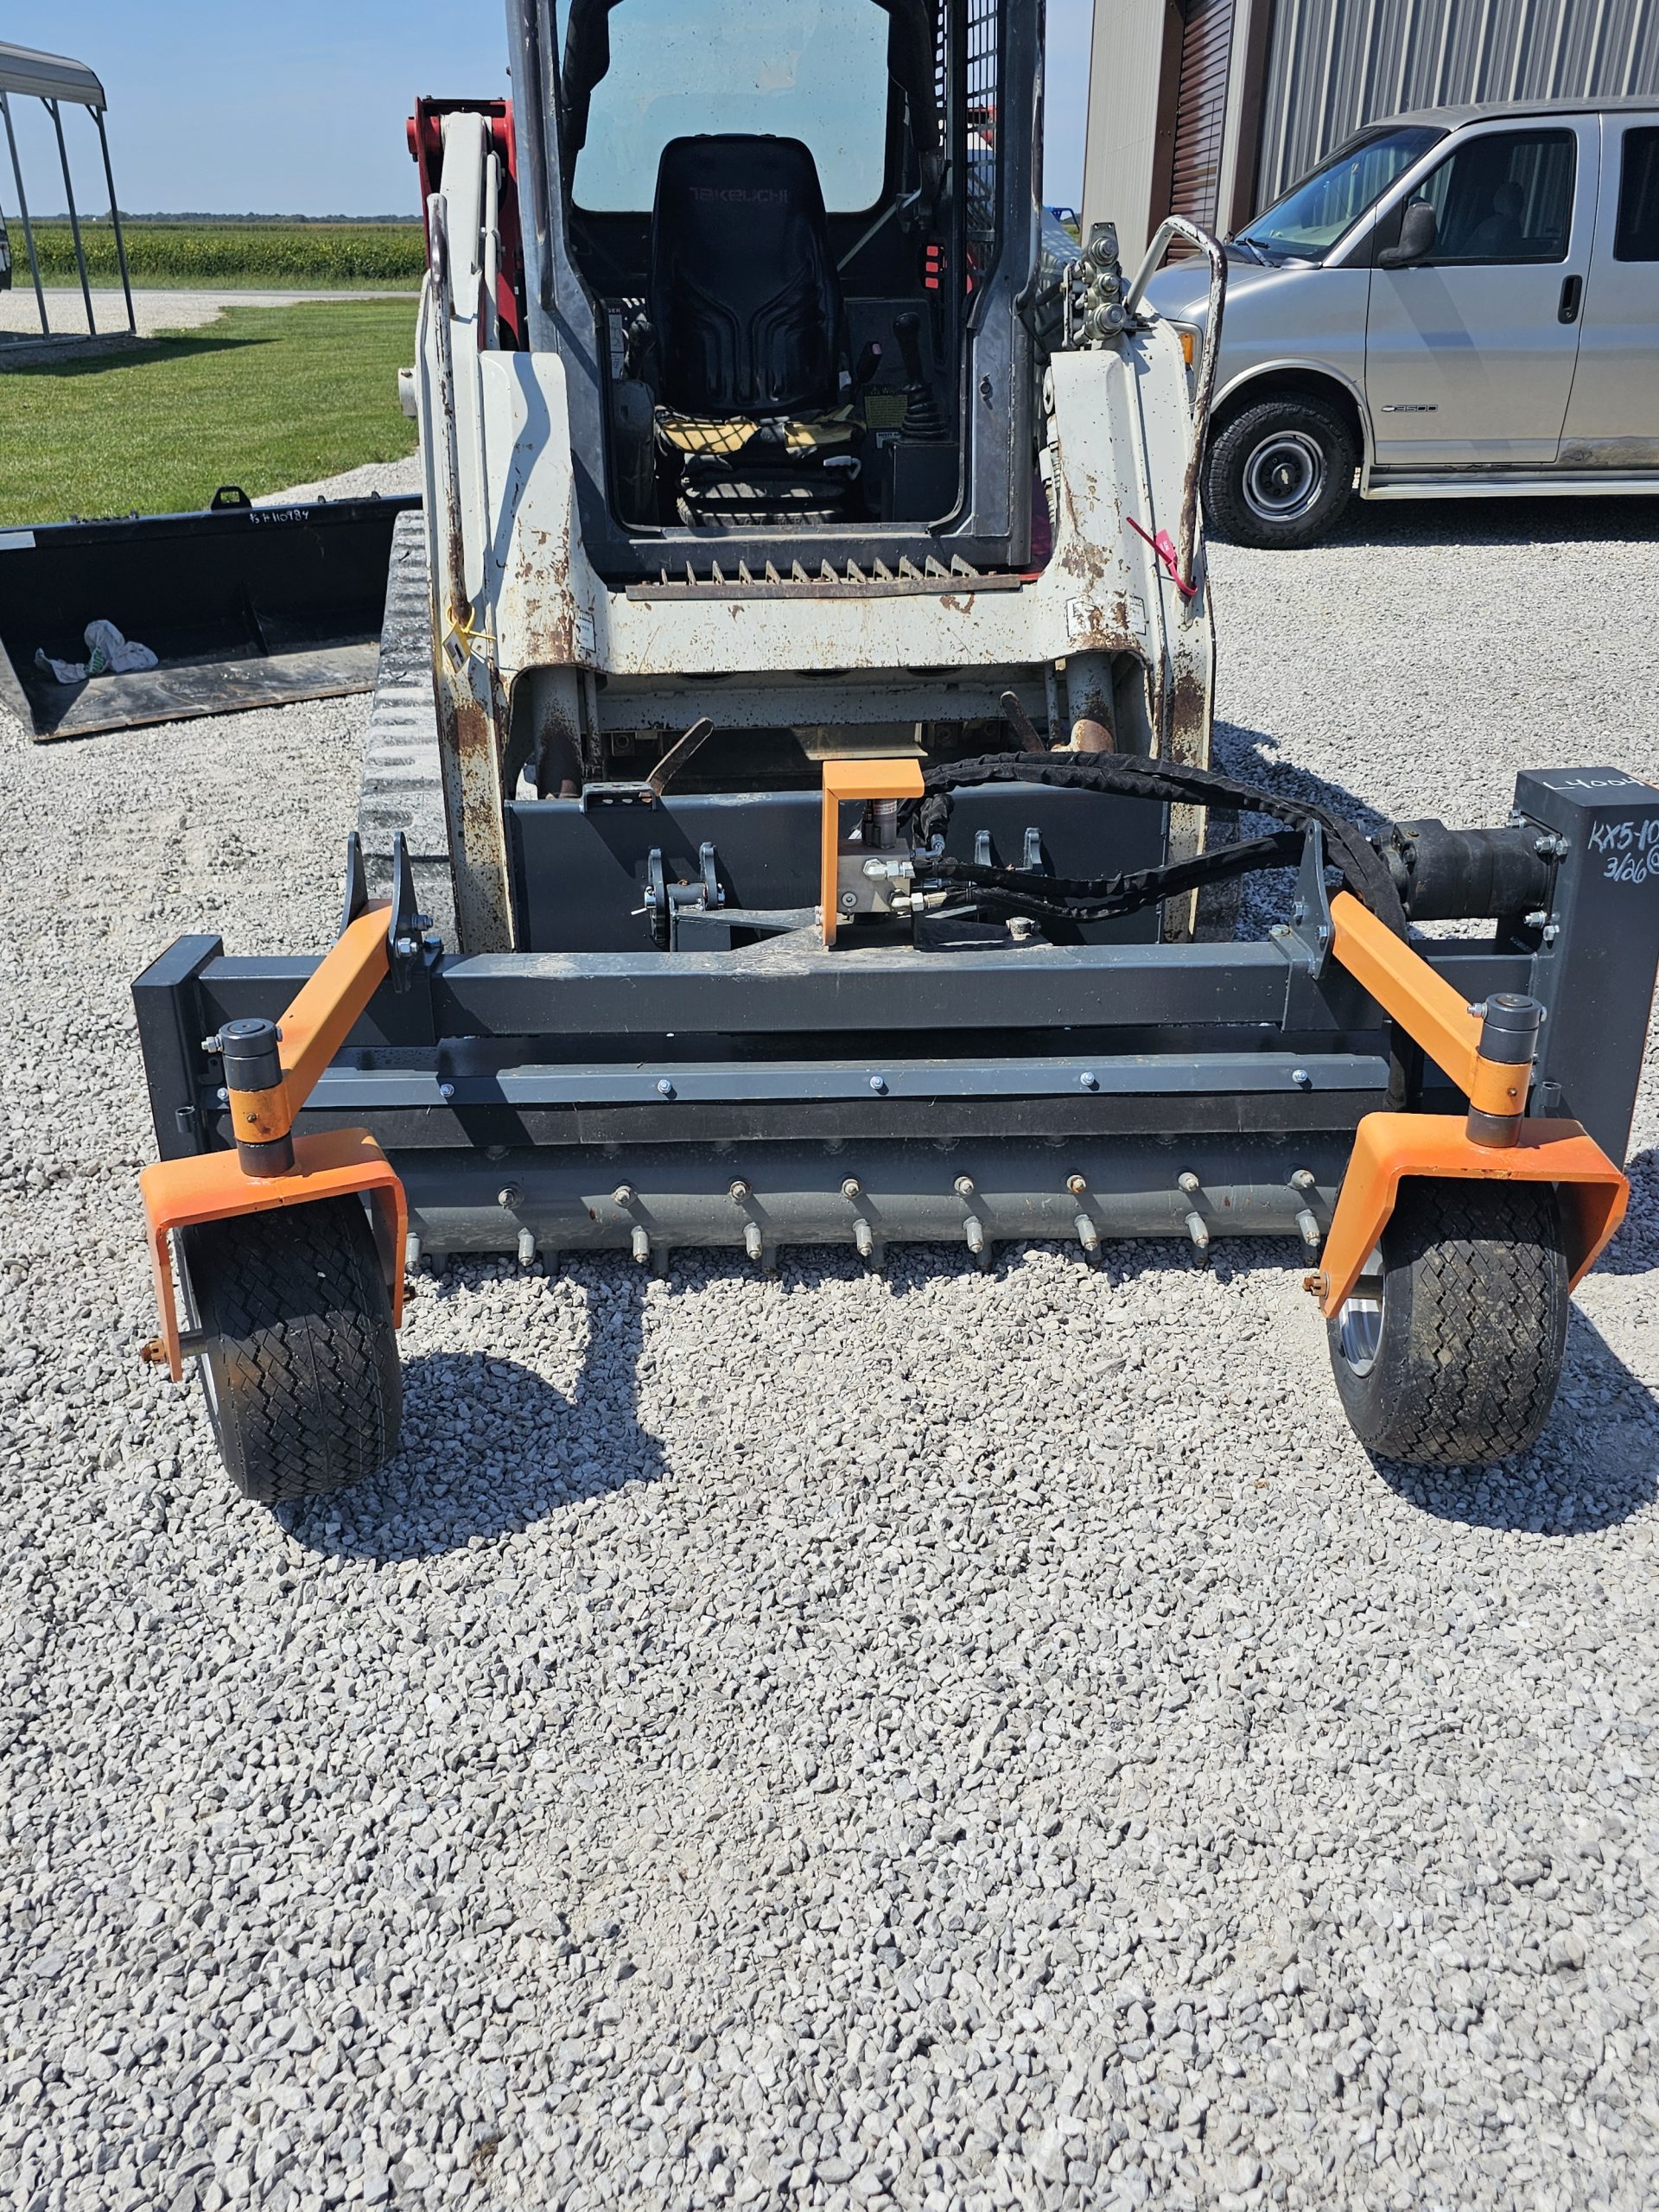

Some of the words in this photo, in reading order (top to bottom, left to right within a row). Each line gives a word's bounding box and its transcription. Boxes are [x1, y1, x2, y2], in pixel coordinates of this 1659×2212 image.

[688, 186, 789, 204] TAKEUCHI
[1395, 404, 1439, 413] 3500
[1542, 776, 1646, 790] L4004
